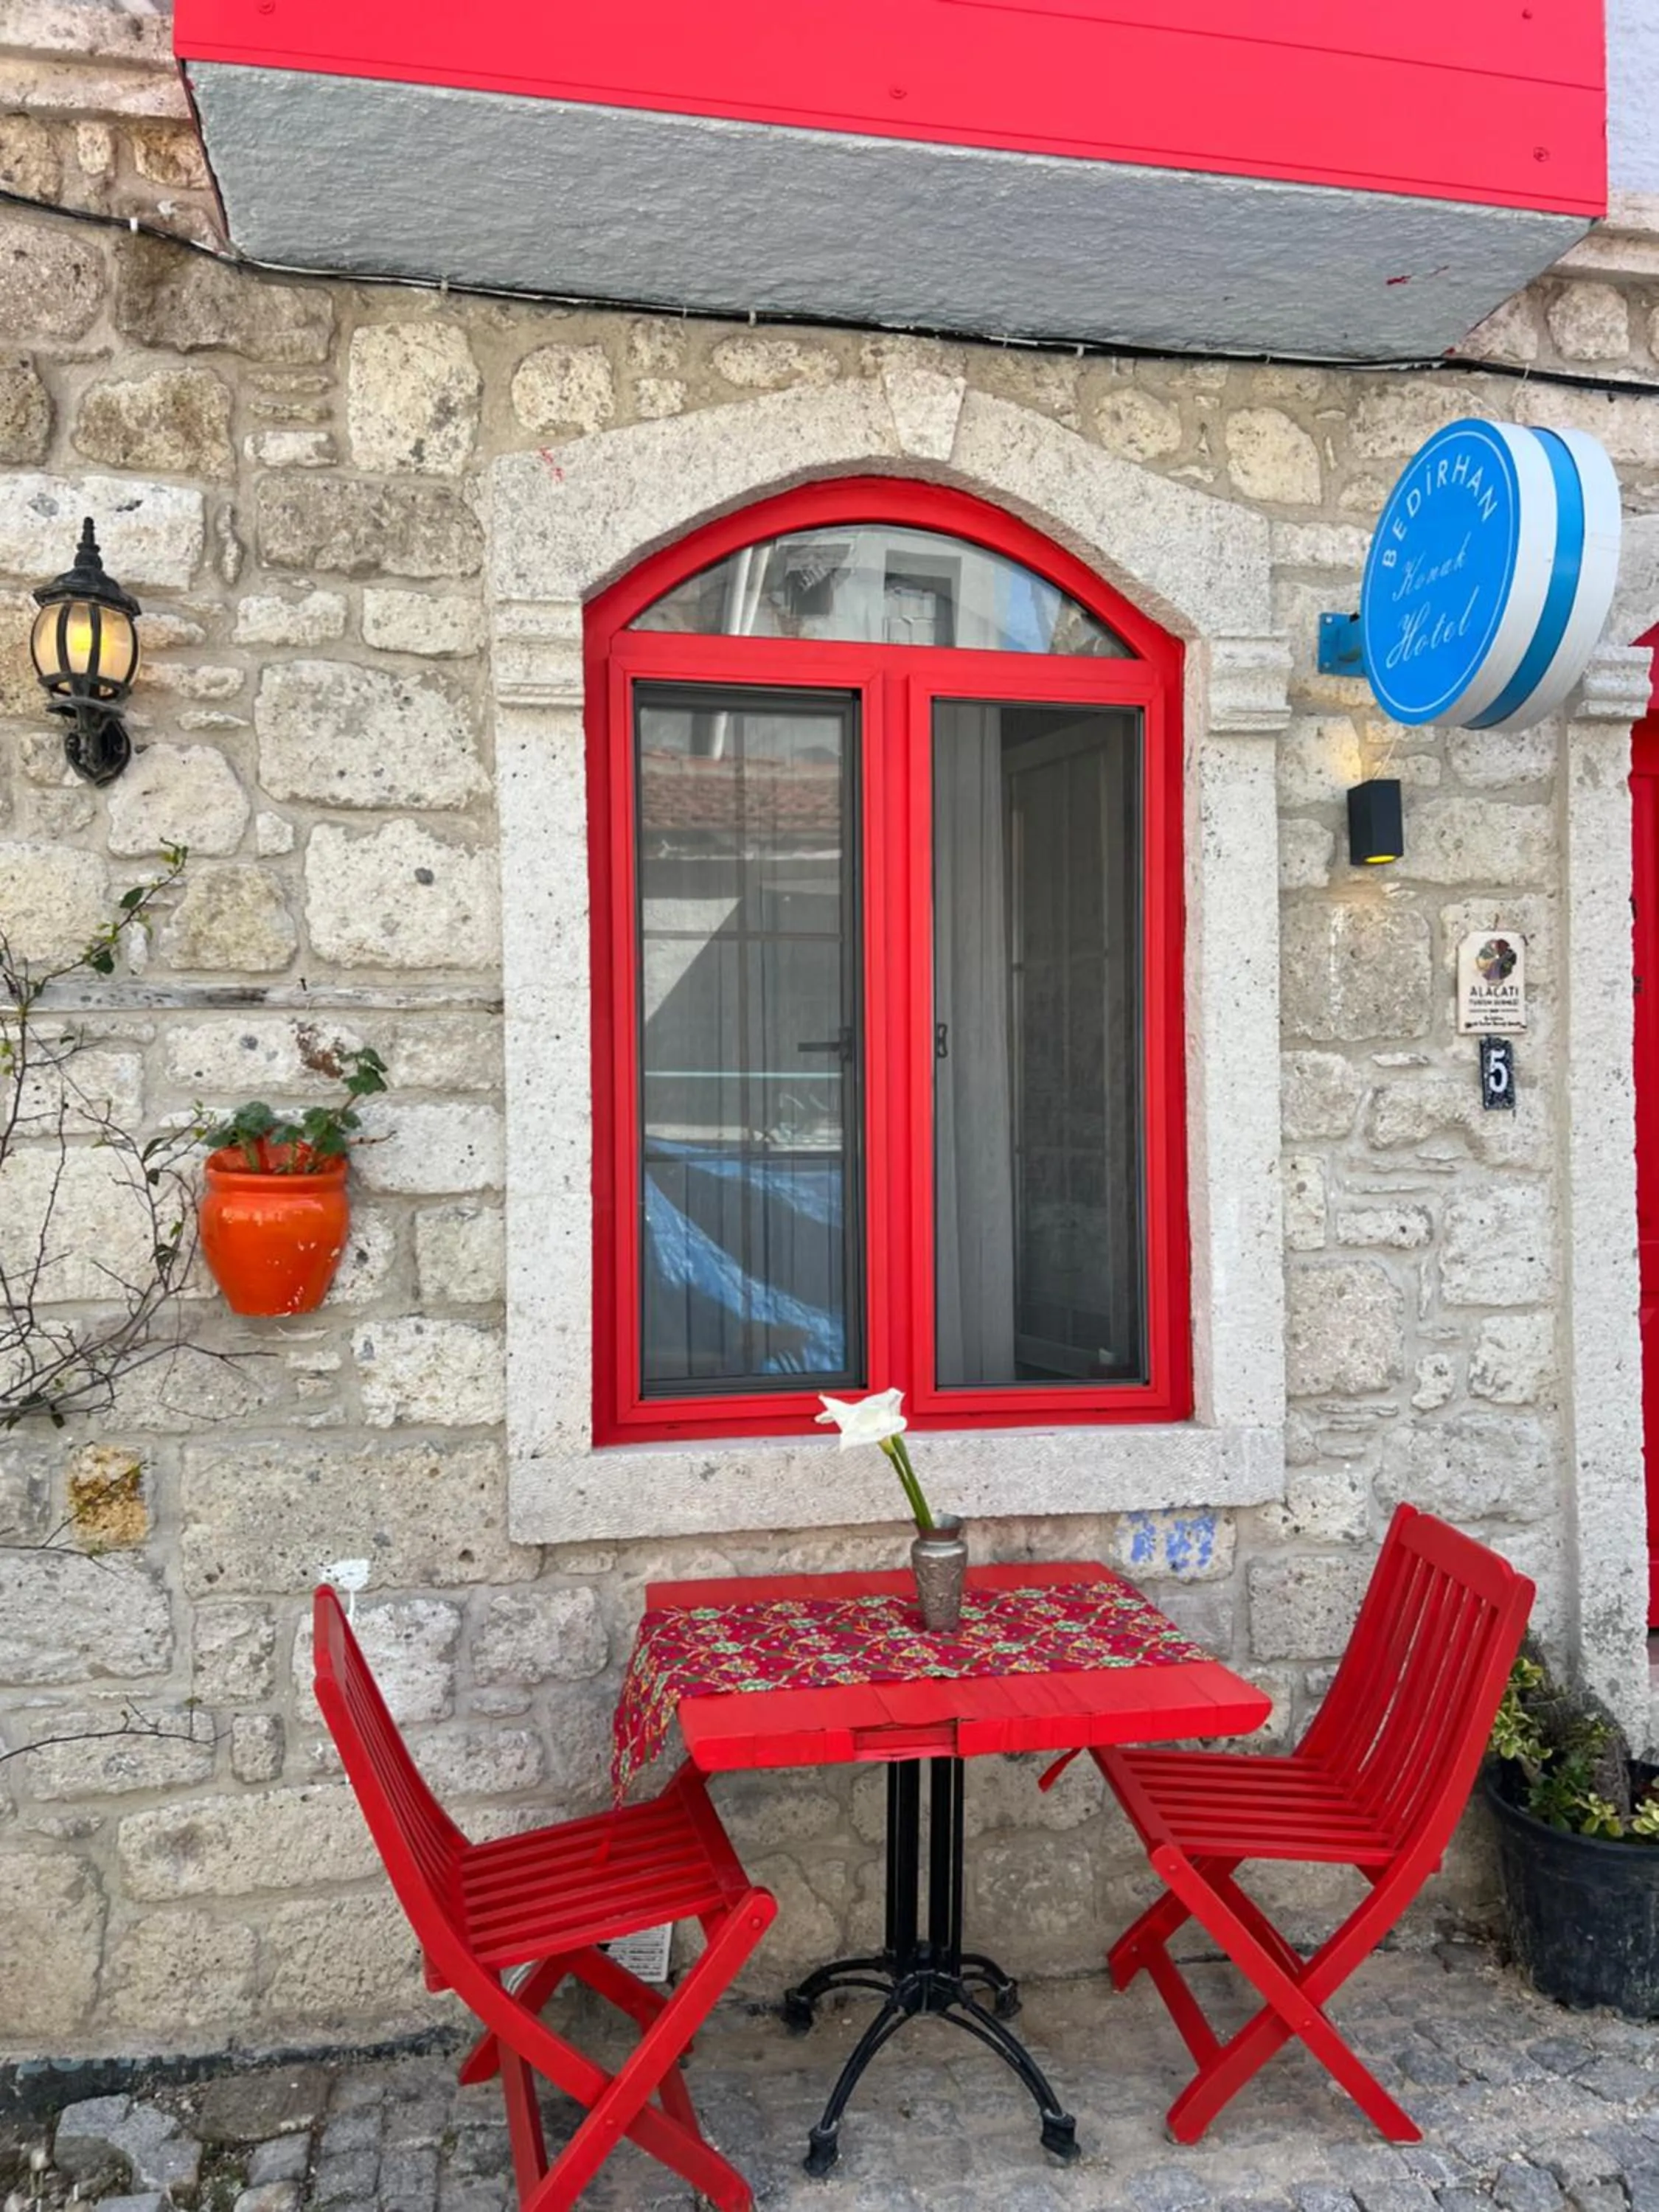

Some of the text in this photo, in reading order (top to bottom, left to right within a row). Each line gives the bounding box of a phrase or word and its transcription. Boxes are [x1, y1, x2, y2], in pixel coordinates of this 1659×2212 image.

[1381, 453, 1498, 568] BEDİRHAN
[1385, 585, 1480, 669] Hotel
[1489, 1048, 1509, 1093] 5
